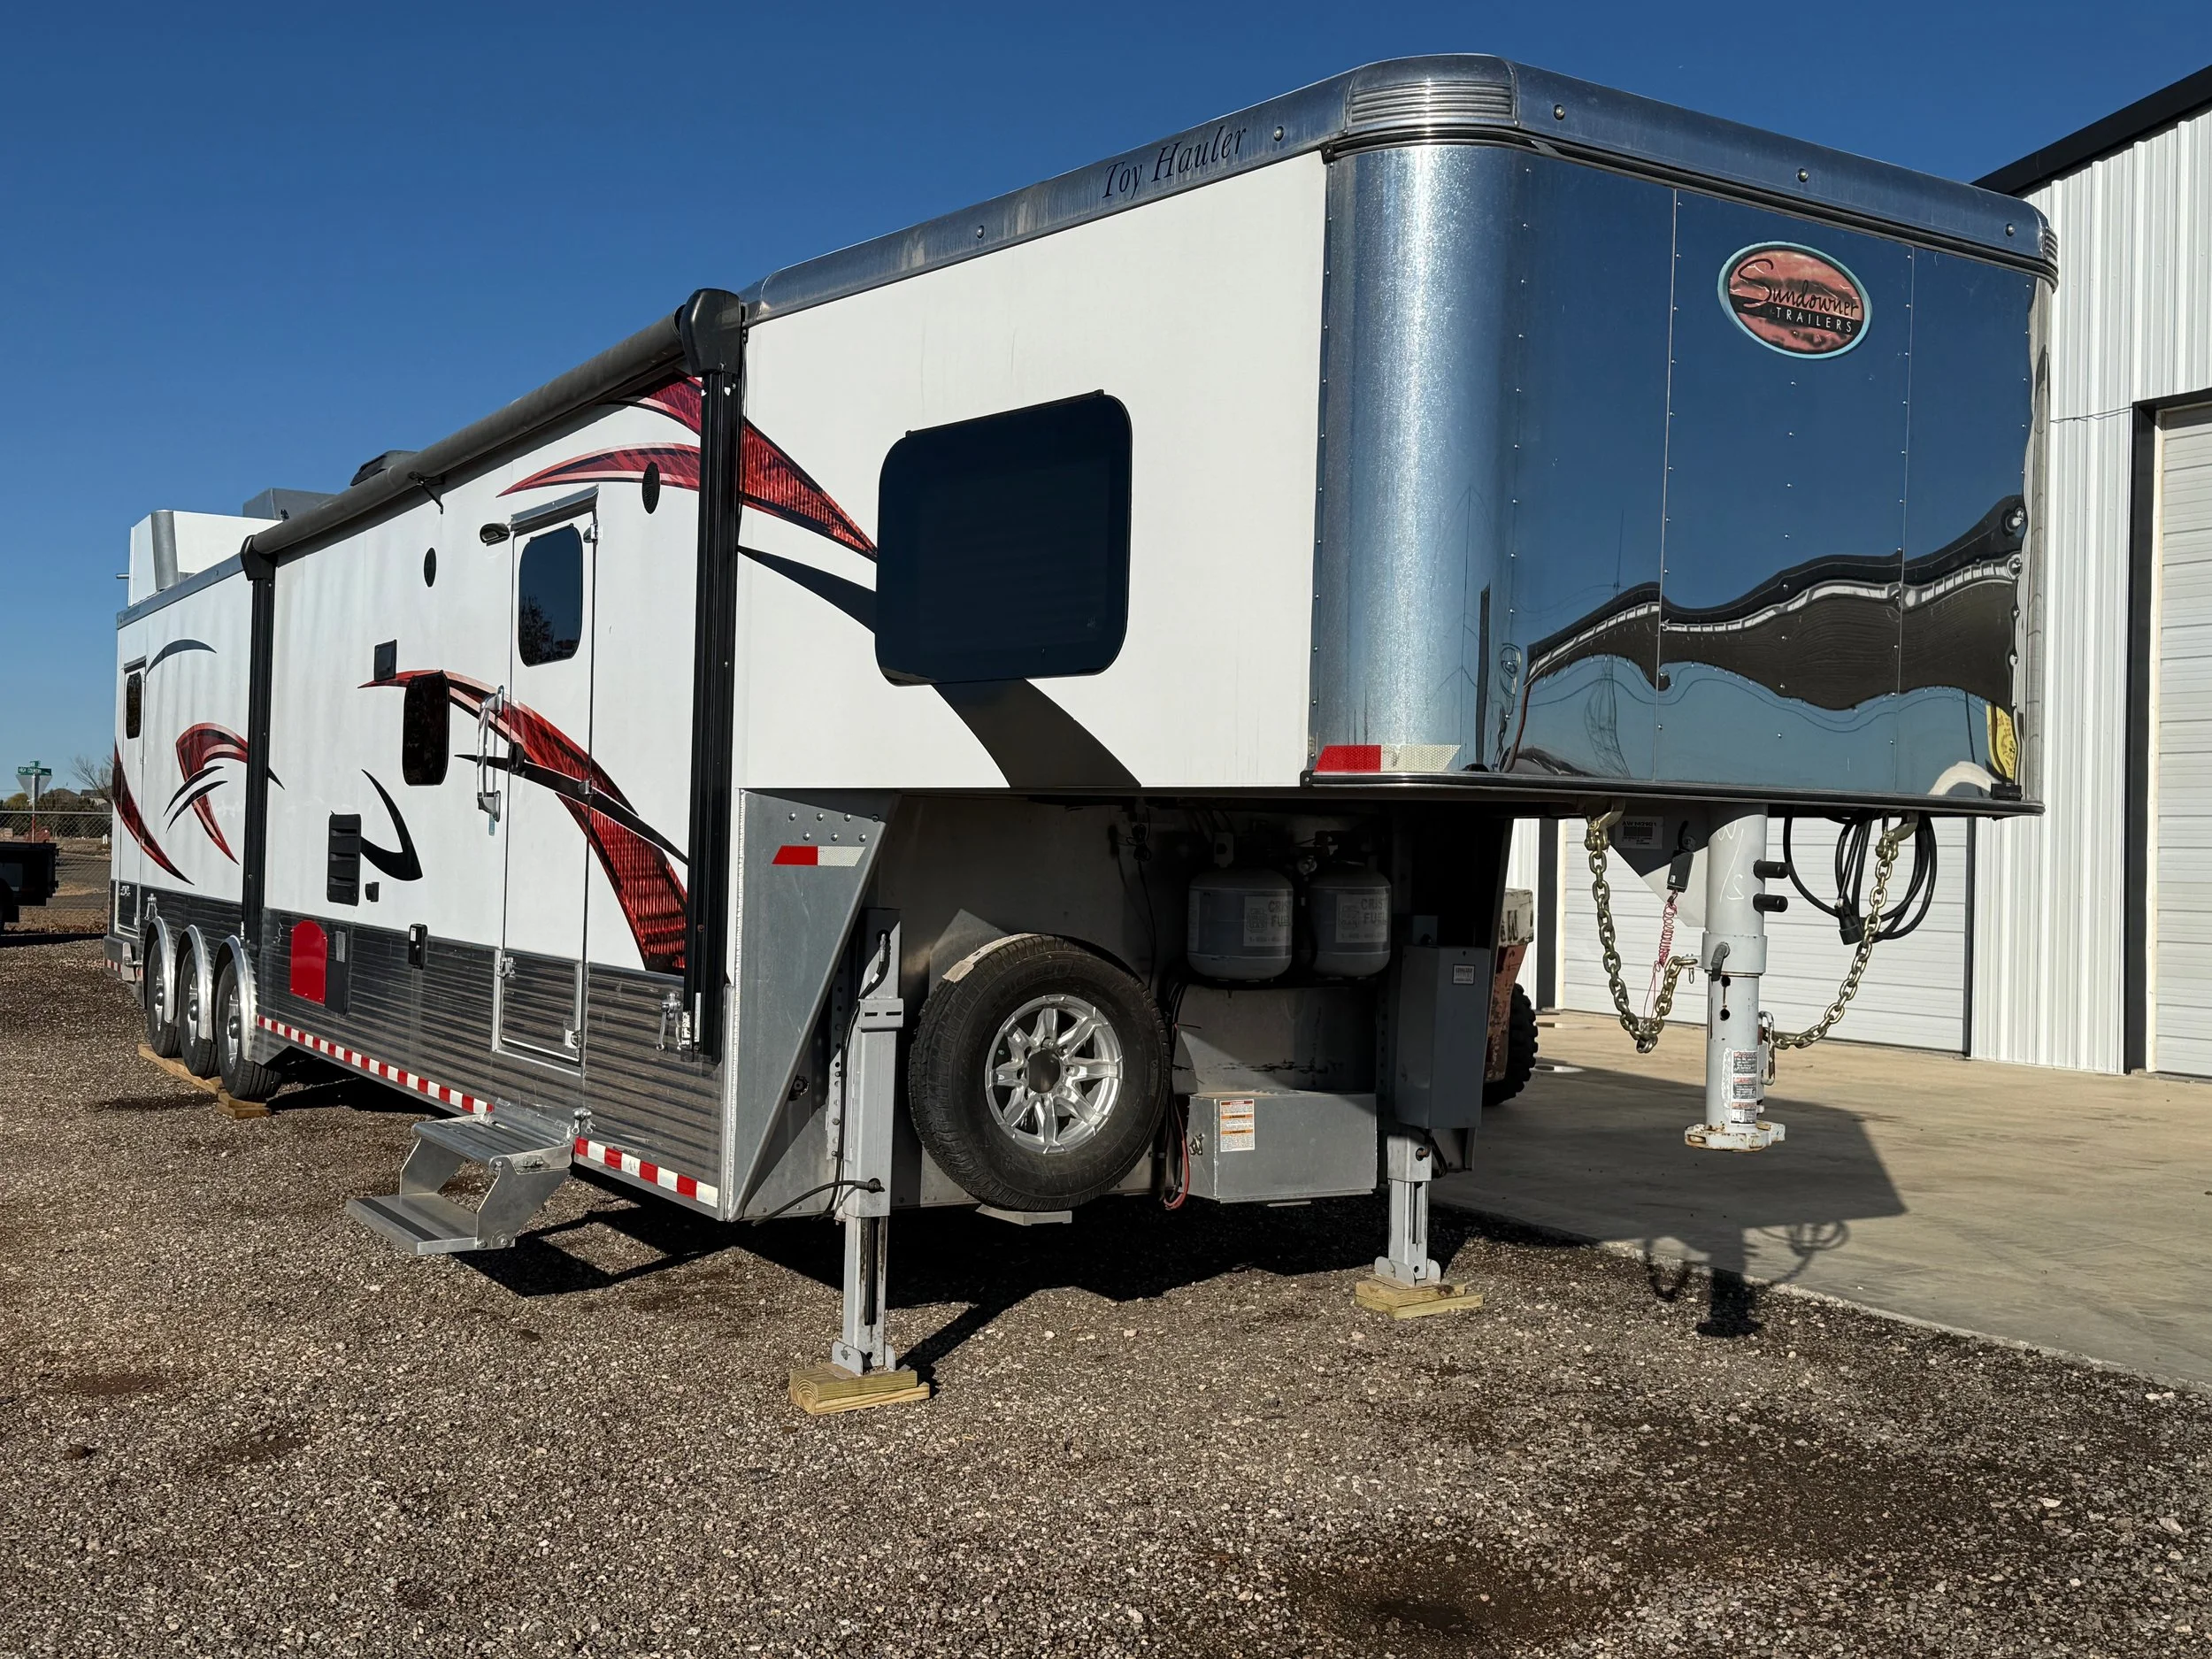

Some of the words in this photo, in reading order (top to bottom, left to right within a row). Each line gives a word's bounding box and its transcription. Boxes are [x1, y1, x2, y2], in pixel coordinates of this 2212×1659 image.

[1102, 161, 1142, 199] Toy
[1150, 125, 1247, 182] Hauler
[1738, 258, 1859, 317] Sundowner
[1776, 306, 1852, 333] TRAILERS
